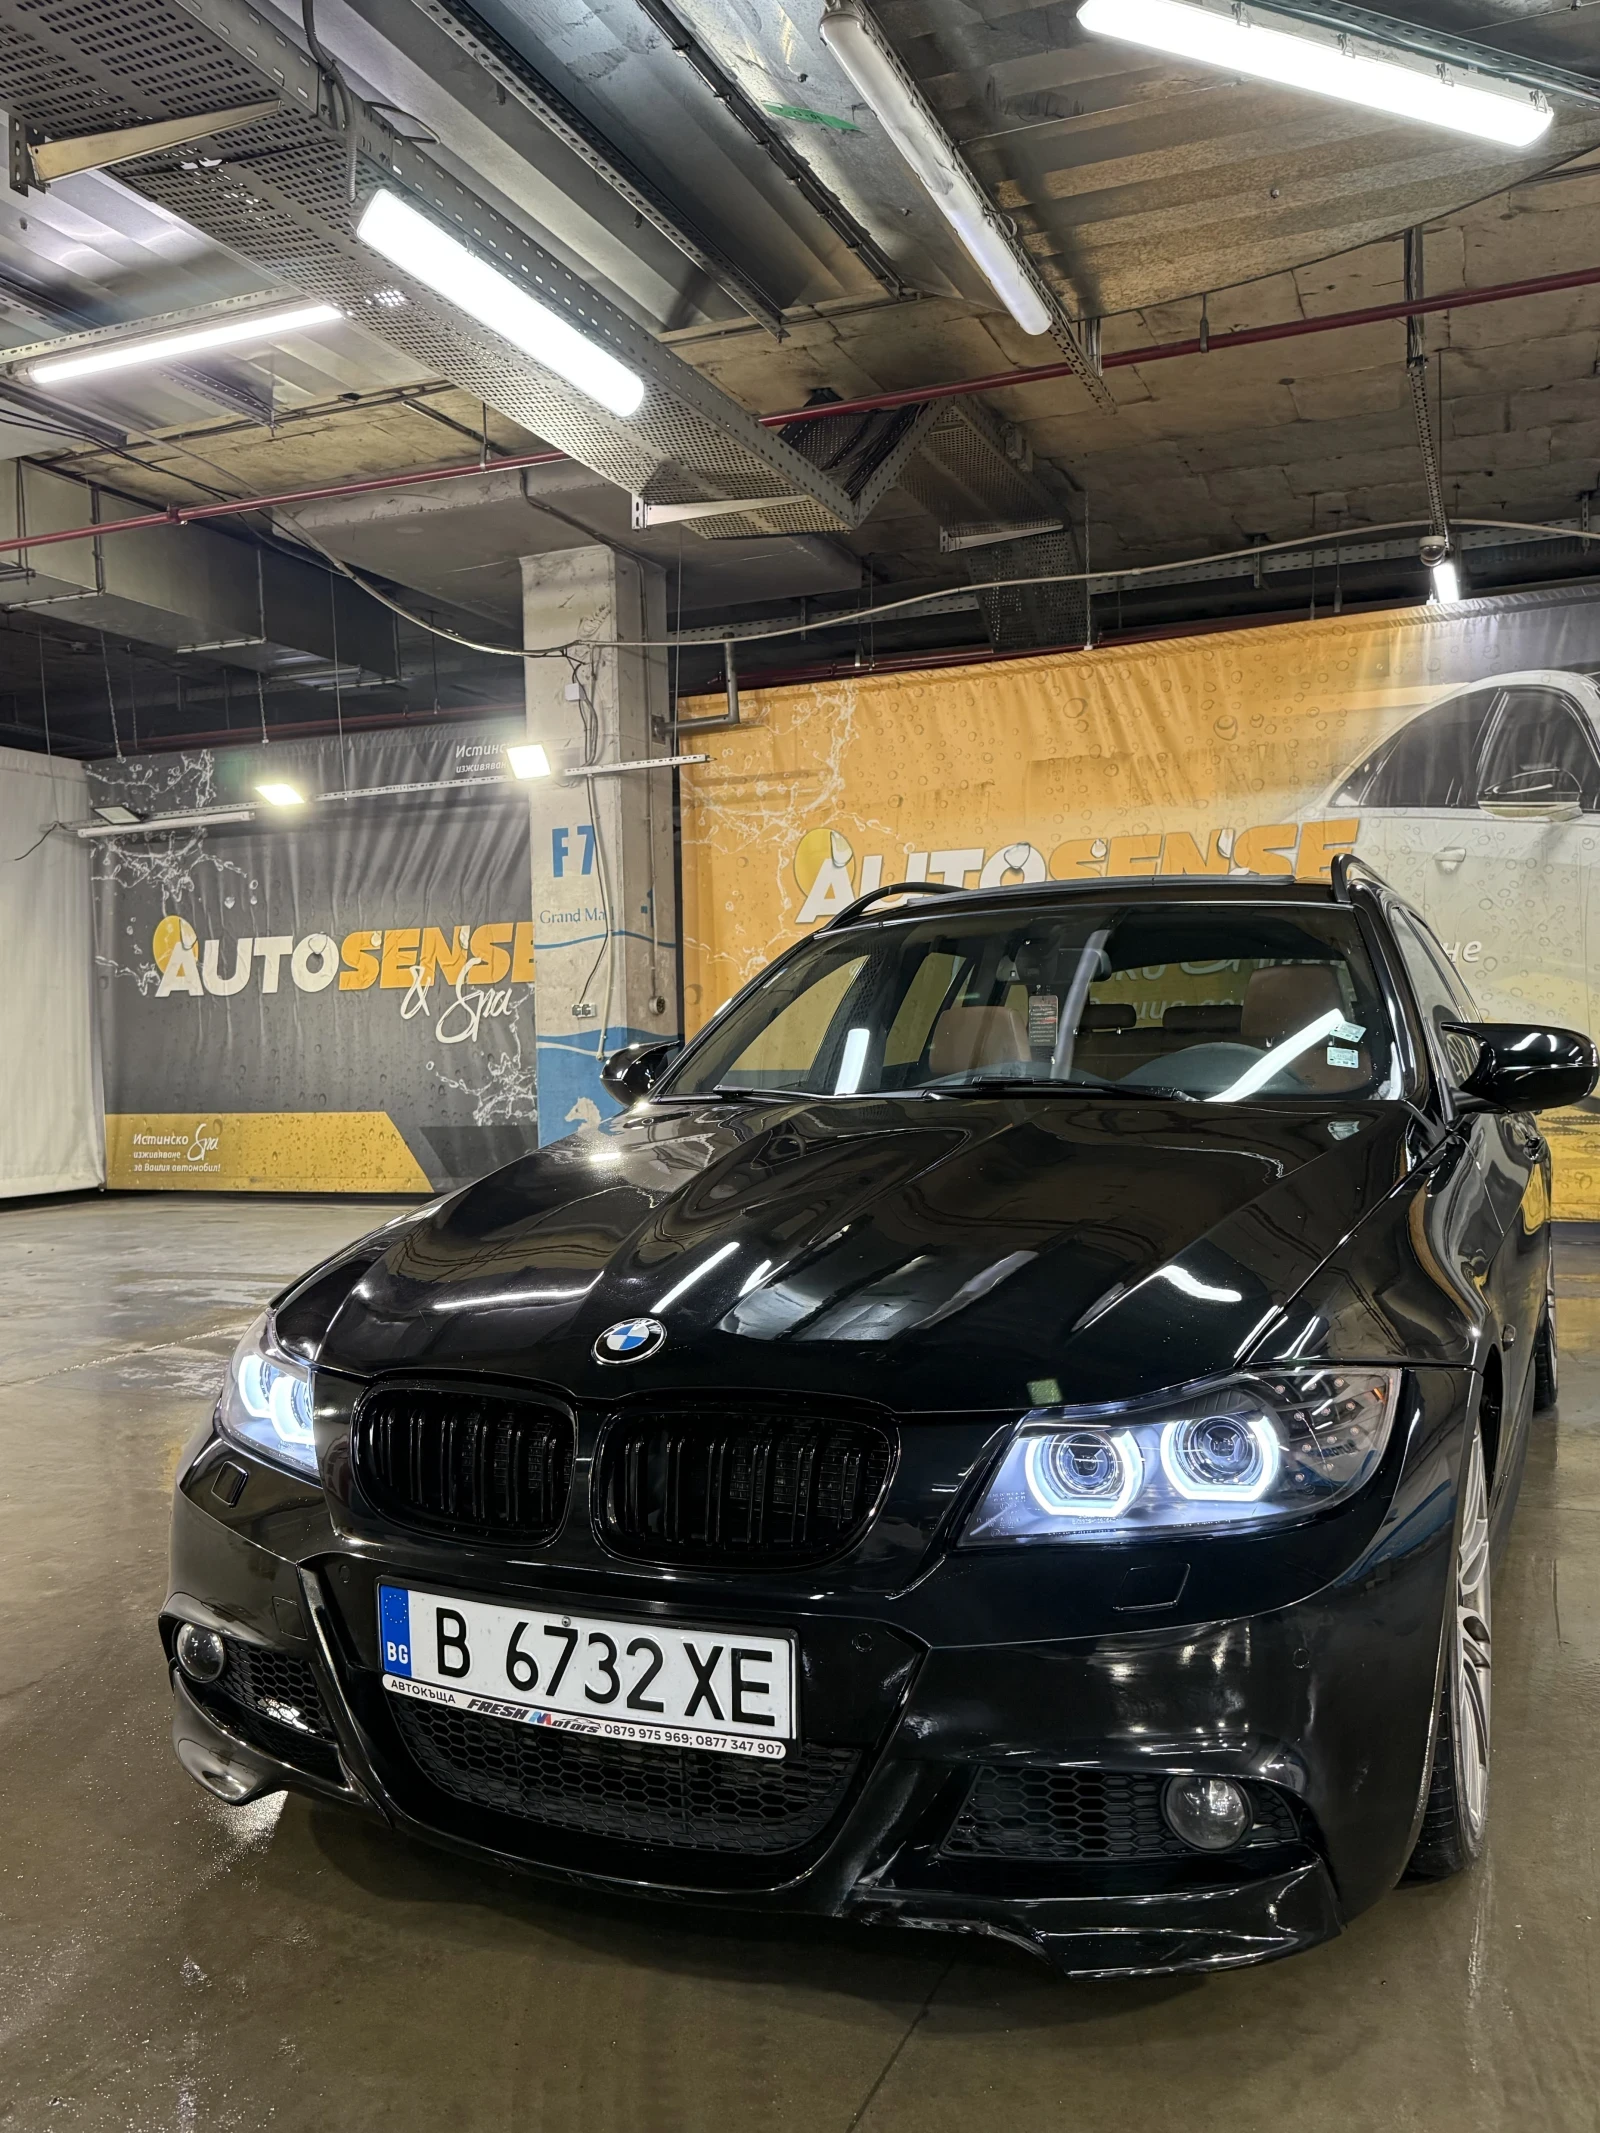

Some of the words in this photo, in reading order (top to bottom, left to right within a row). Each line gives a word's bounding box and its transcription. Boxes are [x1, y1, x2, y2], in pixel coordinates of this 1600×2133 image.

[455, 743, 507, 758] Истинс
[456, 761, 507, 773] изживяван
[539, 908, 581, 924] Grand
[585, 906, 615, 922] Mal
[435, 957, 513, 1044] Spa
[133, 1133, 189, 1145] Истинско
[187, 1123, 219, 1161] Spa
[385, 1640, 409, 1665] BG
[506, 1621, 665, 1714] 6732
[683, 1642, 776, 1727] XE
[390, 1679, 456, 1704] АВТОКЪЩА
[467, 1698, 530, 1720] FRESH
[528, 1711, 600, 1734] Motors
[604, 1724, 636, 1737] 0879
[638, 1728, 661, 1740] 975
[664, 1731, 693, 1746] 969;
[695, 1735, 727, 1749] 0877
[730, 1739, 754, 1752] 347
[757, 1743, 782, 1756] 907
